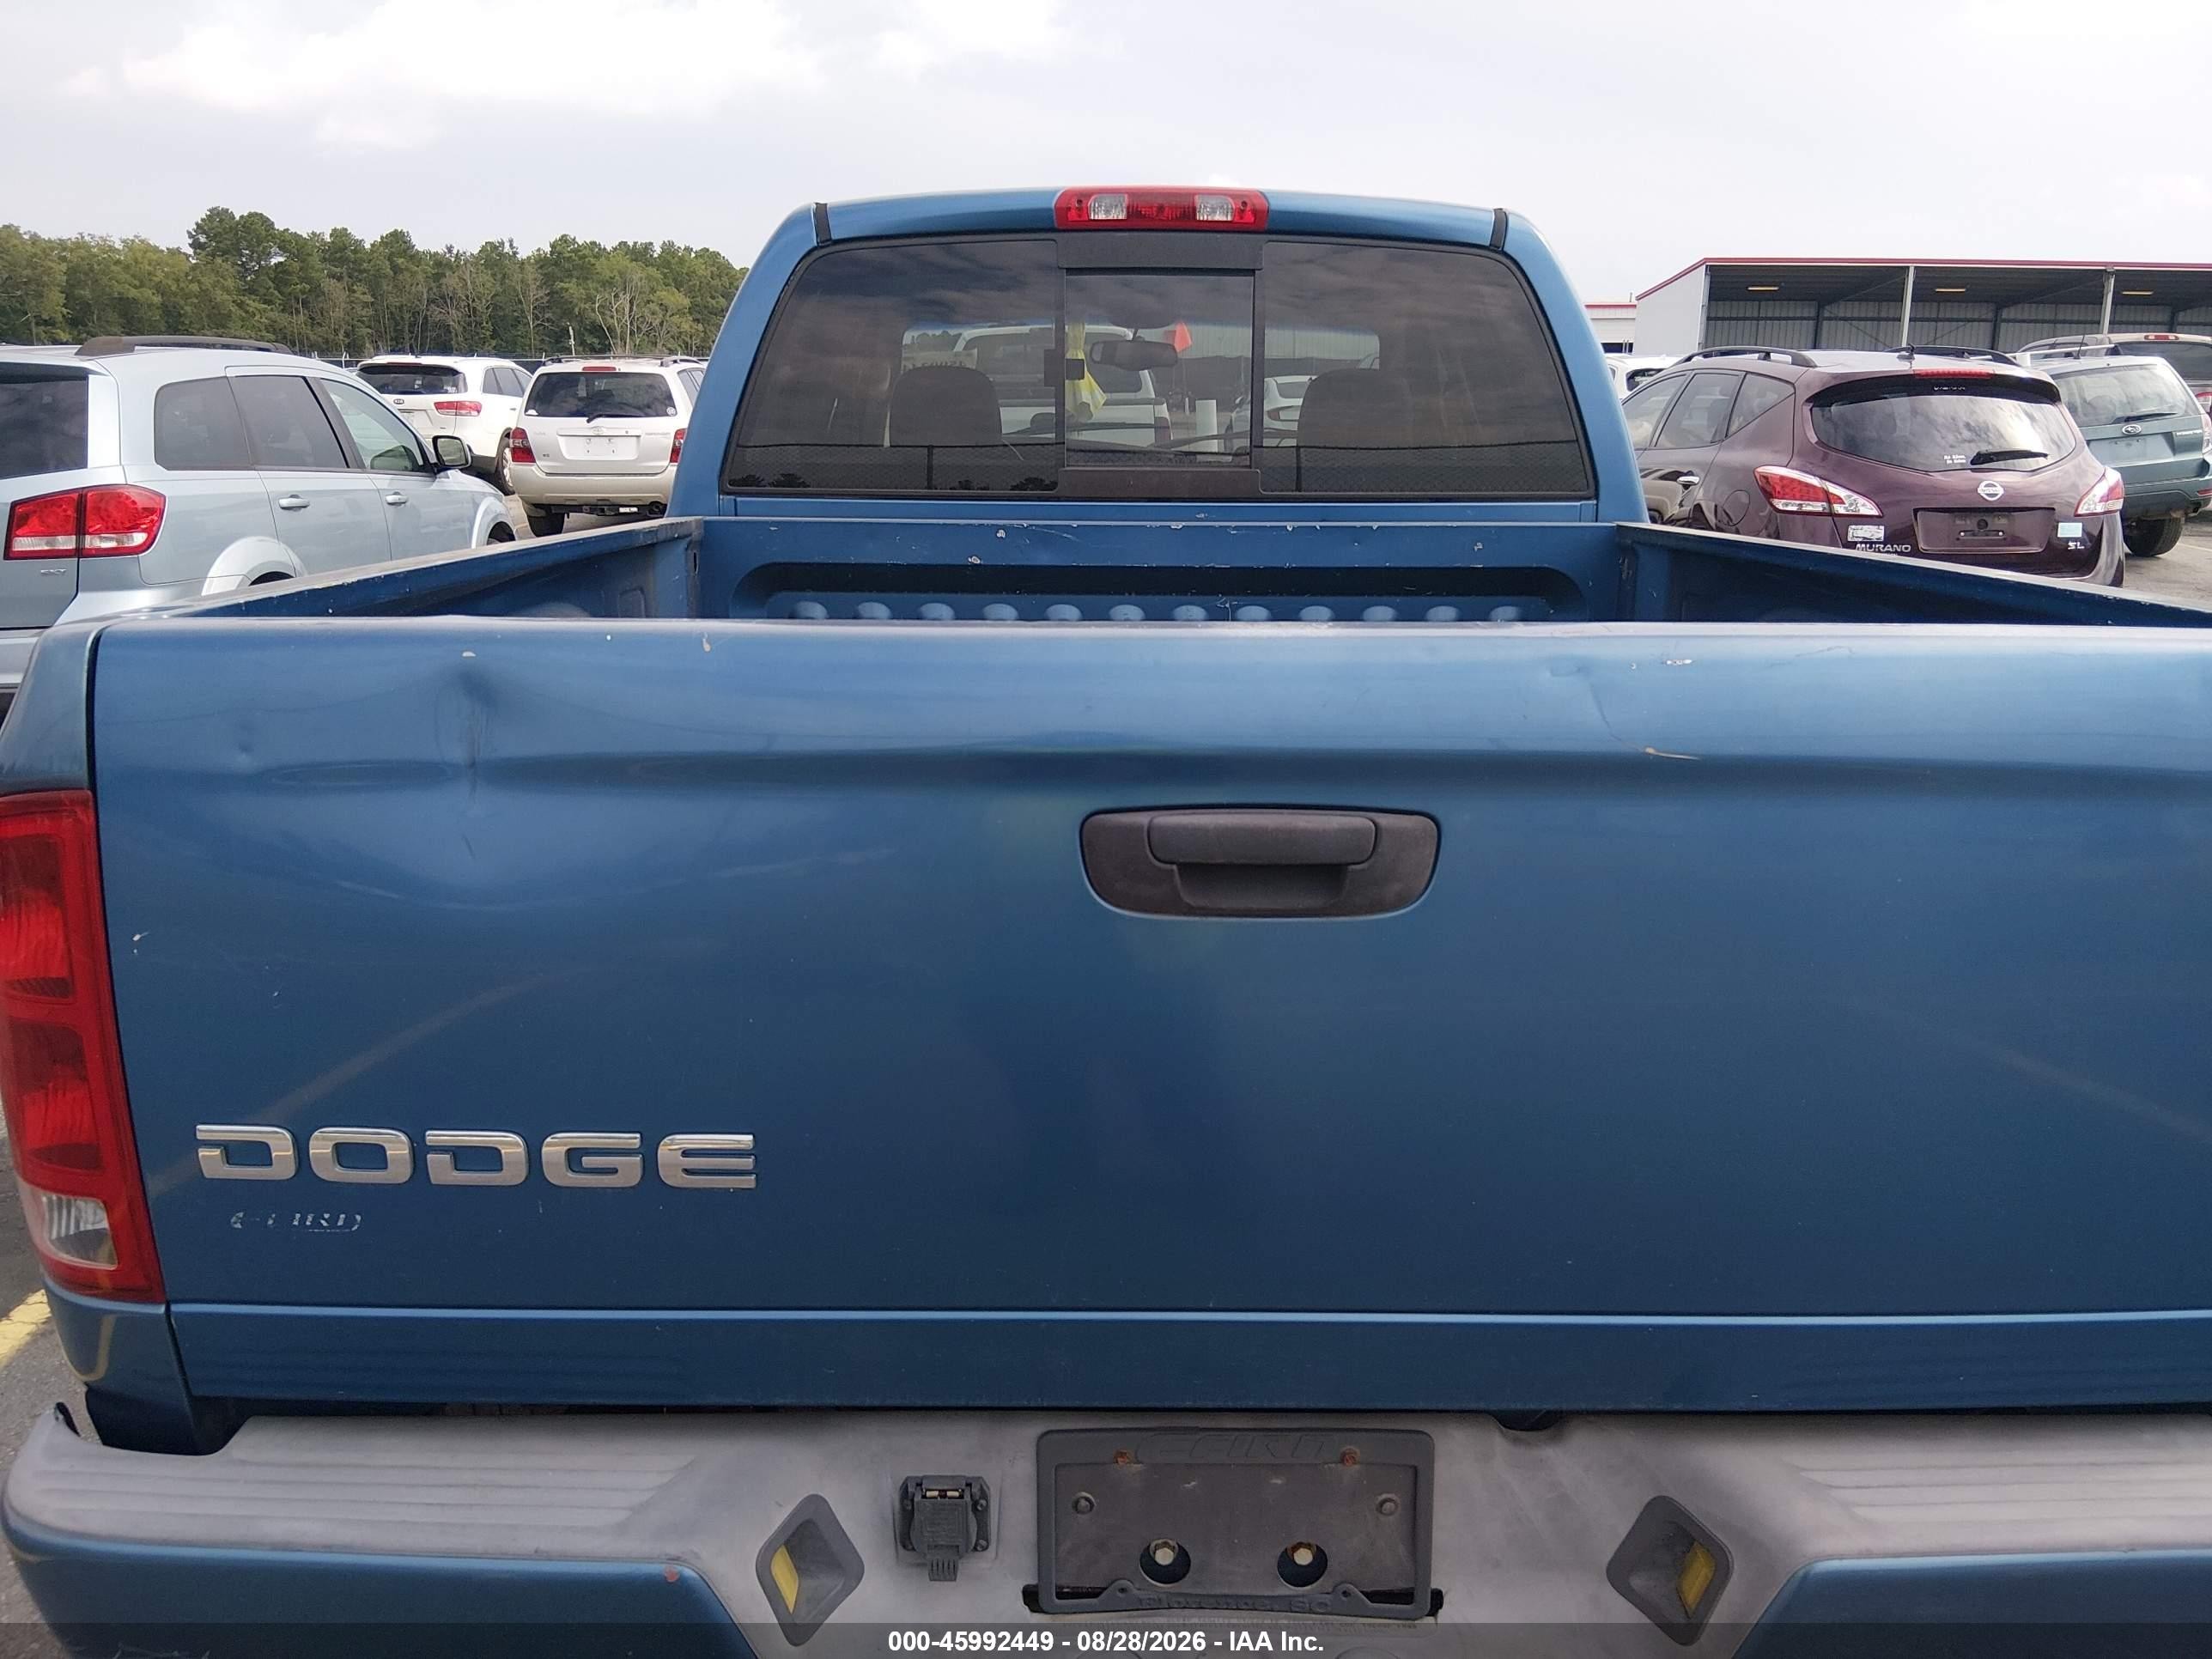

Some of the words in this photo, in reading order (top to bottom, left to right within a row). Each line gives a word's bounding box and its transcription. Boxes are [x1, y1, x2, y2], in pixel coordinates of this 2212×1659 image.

[1856, 543, 1912, 552] MURANO
[2067, 541, 2085, 550] SL
[195, 1123, 757, 1188] DODGE
